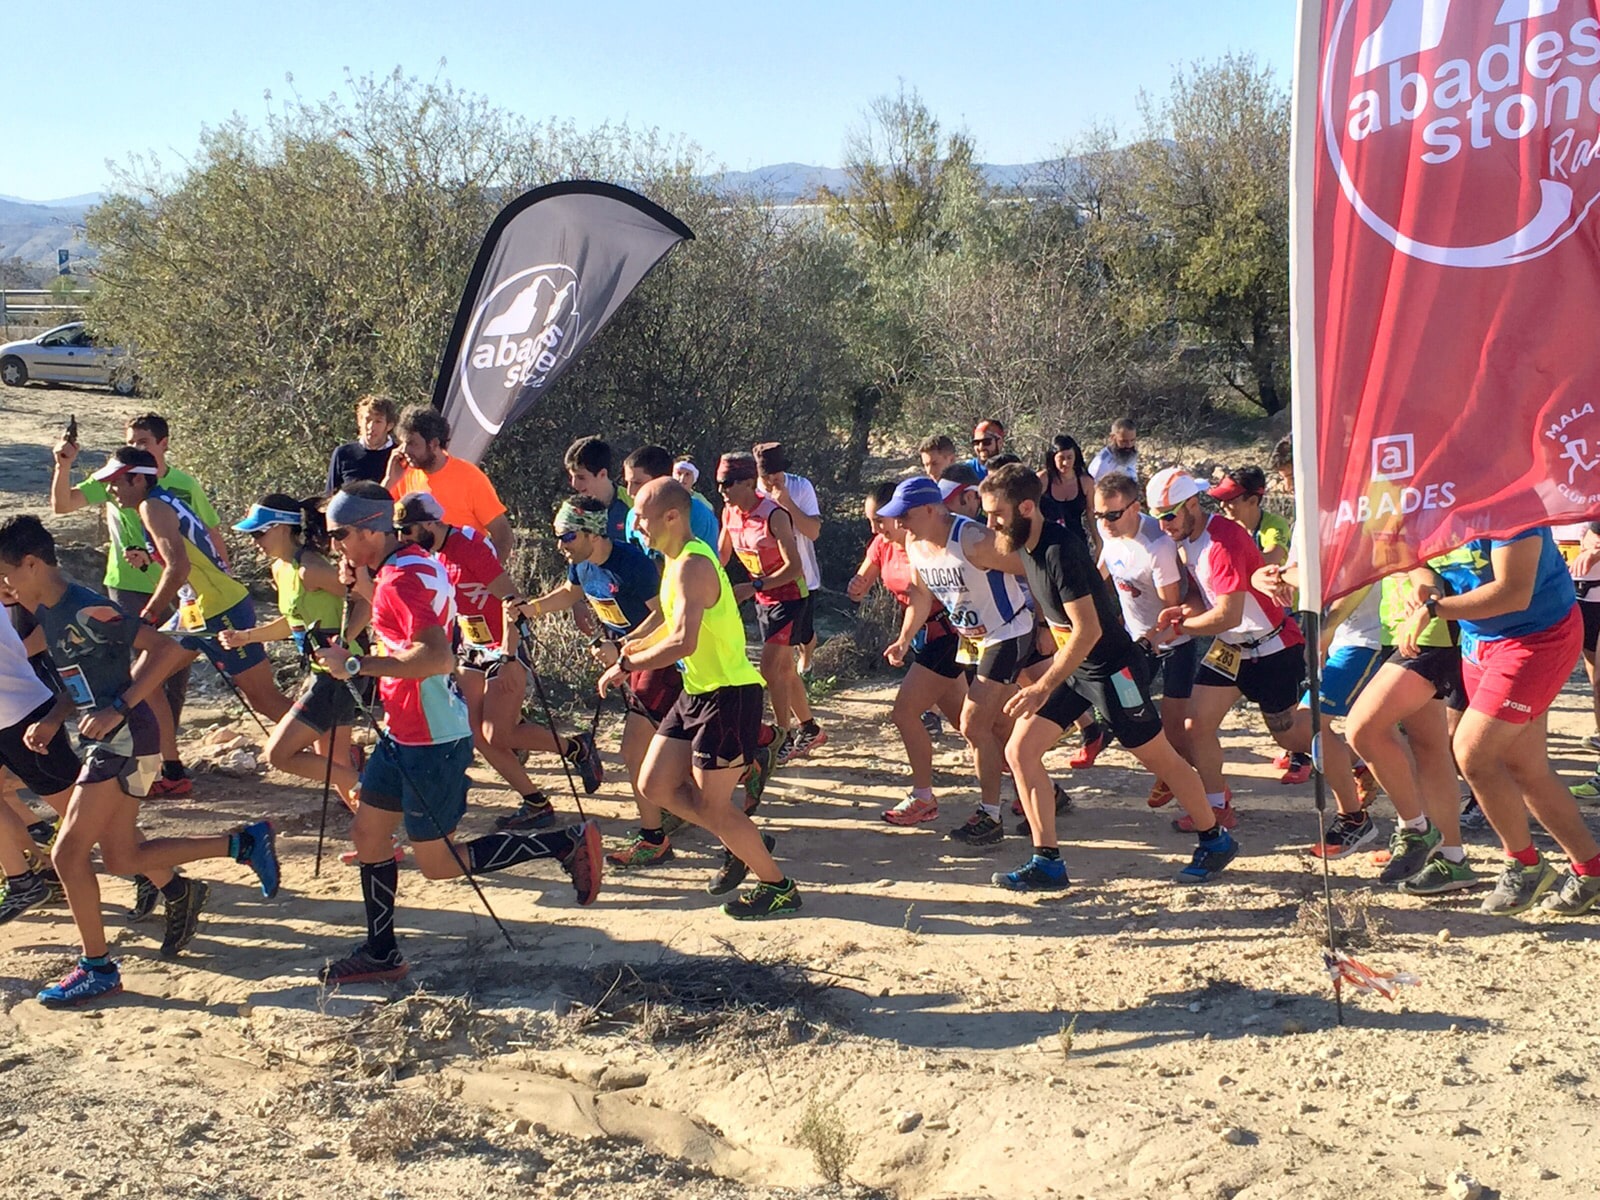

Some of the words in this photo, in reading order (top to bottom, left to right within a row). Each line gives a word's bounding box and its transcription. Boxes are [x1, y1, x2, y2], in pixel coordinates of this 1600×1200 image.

[1348, 17, 1600, 141] abades
[1545, 403, 1594, 440] MALA
[1334, 482, 1457, 529] ABADES
[1557, 483, 1586, 504] CLUB
[1216, 648, 1234, 667] 283
